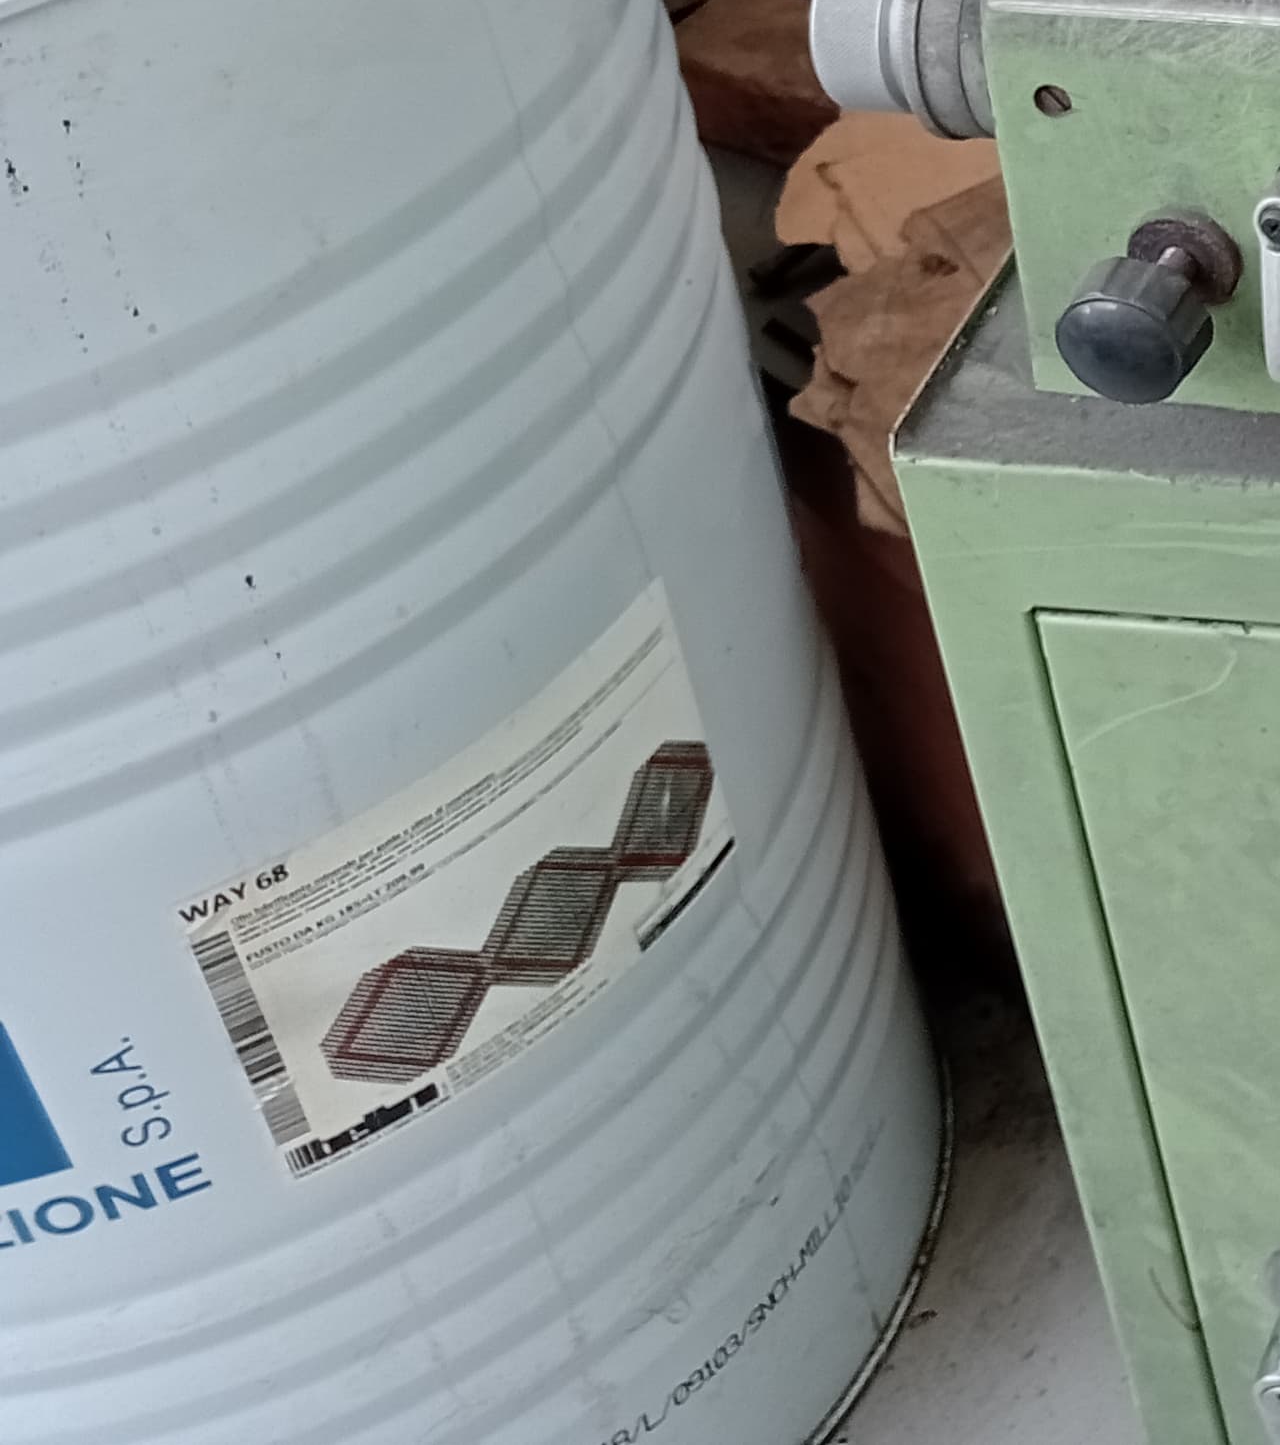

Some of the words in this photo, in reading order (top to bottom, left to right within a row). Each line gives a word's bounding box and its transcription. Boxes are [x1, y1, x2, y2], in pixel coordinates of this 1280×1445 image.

[178, 881, 247, 927] WAY
[255, 863, 290, 890] 68
[90, 1035, 172, 1148] S.p.A.
